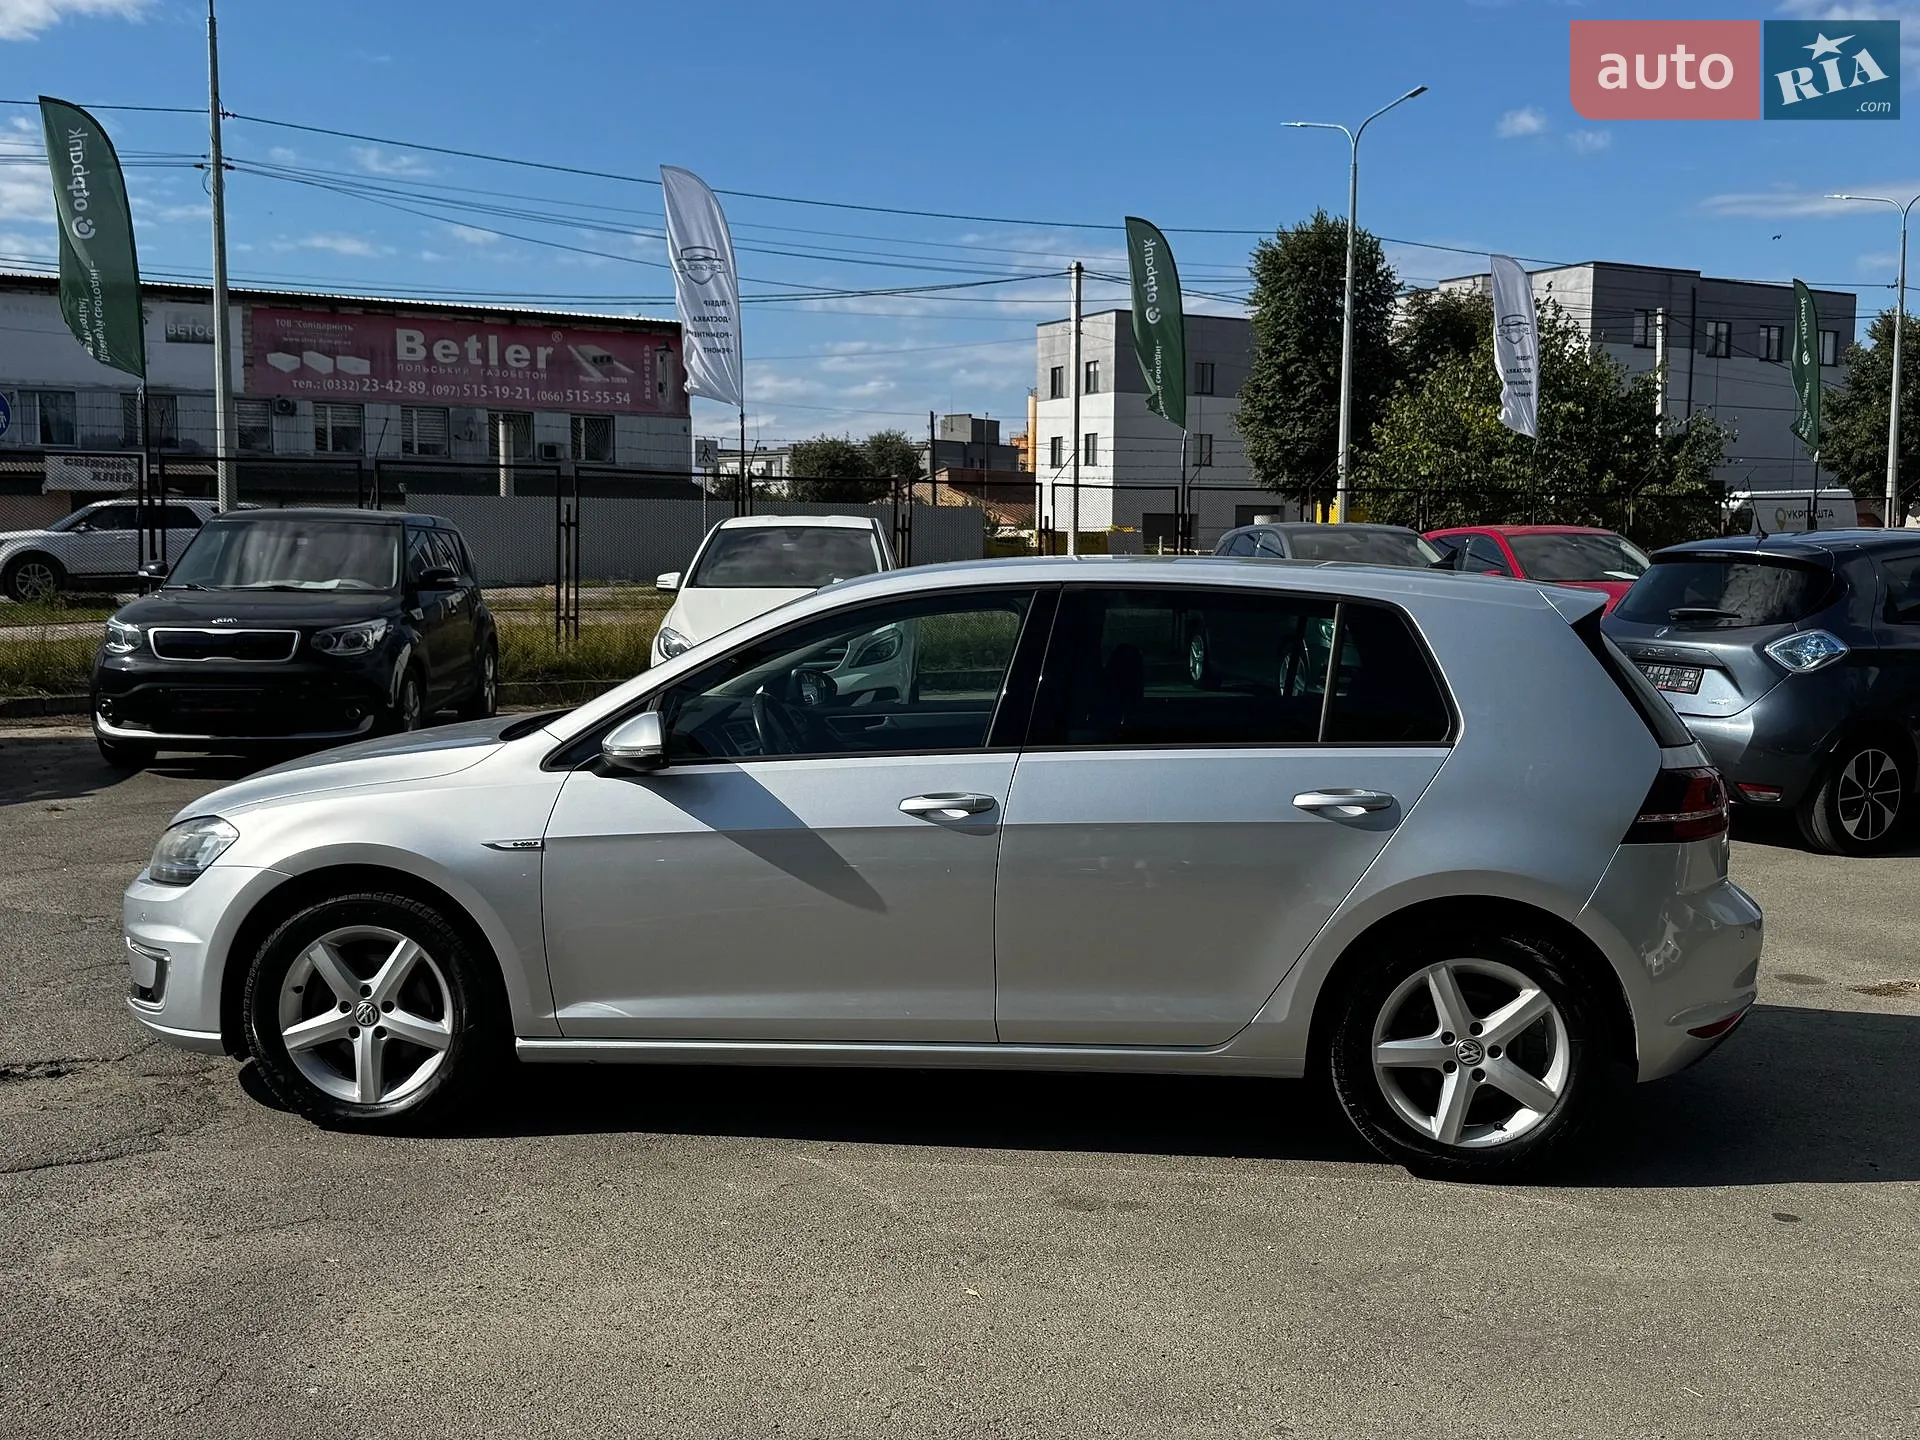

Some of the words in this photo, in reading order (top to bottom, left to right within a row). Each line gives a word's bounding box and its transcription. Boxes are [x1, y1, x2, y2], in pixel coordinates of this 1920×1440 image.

[396, 327, 554, 369] Betler
[480, 367, 548, 381] ГАЗОБЕТОН
[323, 378, 360, 392] (0332)
[432, 383, 460, 398] (097)
[537, 389, 564, 404] (066)
[566, 388, 631, 405] 515-55-54
